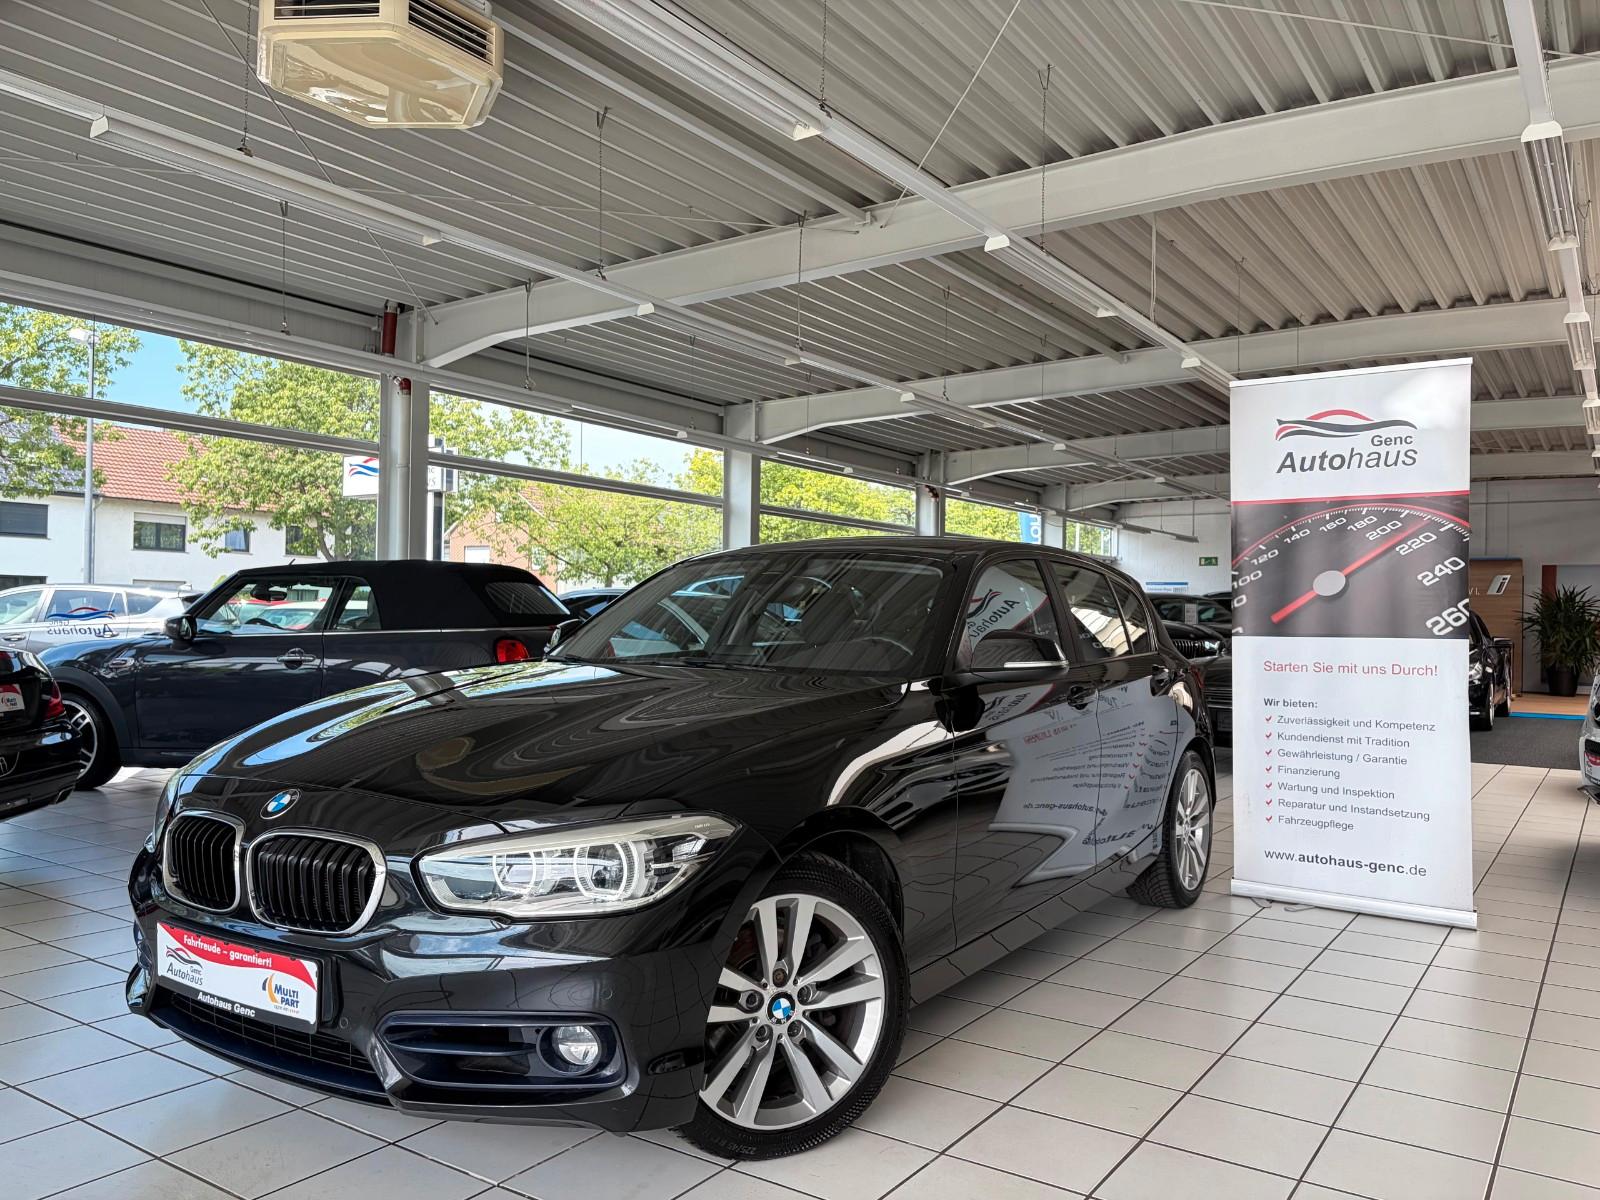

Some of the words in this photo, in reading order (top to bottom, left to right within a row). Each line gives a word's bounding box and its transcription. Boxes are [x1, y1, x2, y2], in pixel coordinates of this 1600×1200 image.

[1371, 434, 1414, 447] Genc
[1276, 447, 1419, 474] Autohaus
[1319, 517, 1347, 532] 160
[1347, 515, 1378, 532] 180
[1365, 520, 1403, 541] 200
[1283, 528, 1311, 544] 140
[1395, 532, 1438, 556] 220
[1417, 556, 1466, 587] 240
[1263, 660, 1309, 673] Starten
[1312, 661, 1334, 674] Sie
[1338, 662, 1358, 674] mit
[1362, 665, 1387, 675] uns
[1391, 663, 1439, 677] Durch!
[1263, 697, 1280, 707] Wir
[1282, 698, 1318, 709] bieten:
[1277, 715, 1350, 728] Zuverlässigkeit
[1353, 720, 1372, 728] und
[1375, 719, 1436, 731] Kompetenz
[1277, 731, 1344, 744] Kundendienst
[1346, 736, 1362, 745] mit
[1364, 736, 1410, 748] Tradition
[1277, 748, 1353, 763] Gewährleistung
[1362, 753, 1408, 765] Garantie
[1277, 765, 1341, 780] Finanzierung
[1277, 781, 1318, 795] Wartung
[1321, 786, 1340, 795] und
[1342, 786, 1395, 799] Inspektion
[1278, 798, 1326, 811] Reparatur
[1328, 803, 1348, 812] und
[1350, 804, 1430, 822] Instandsetzung
[1278, 815, 1354, 831] Fahrzeugpflege
[1264, 849, 1427, 877] www.autohaus-genc.de
[183, 934, 221, 955] Fahrfreude
[229, 951, 272, 968] garantiert!
[166, 961, 204, 986] Autohaus
[198, 992, 232, 1011] Autohaus
[233, 1003, 256, 1018] Genc
[280, 996, 300, 1009] PART
